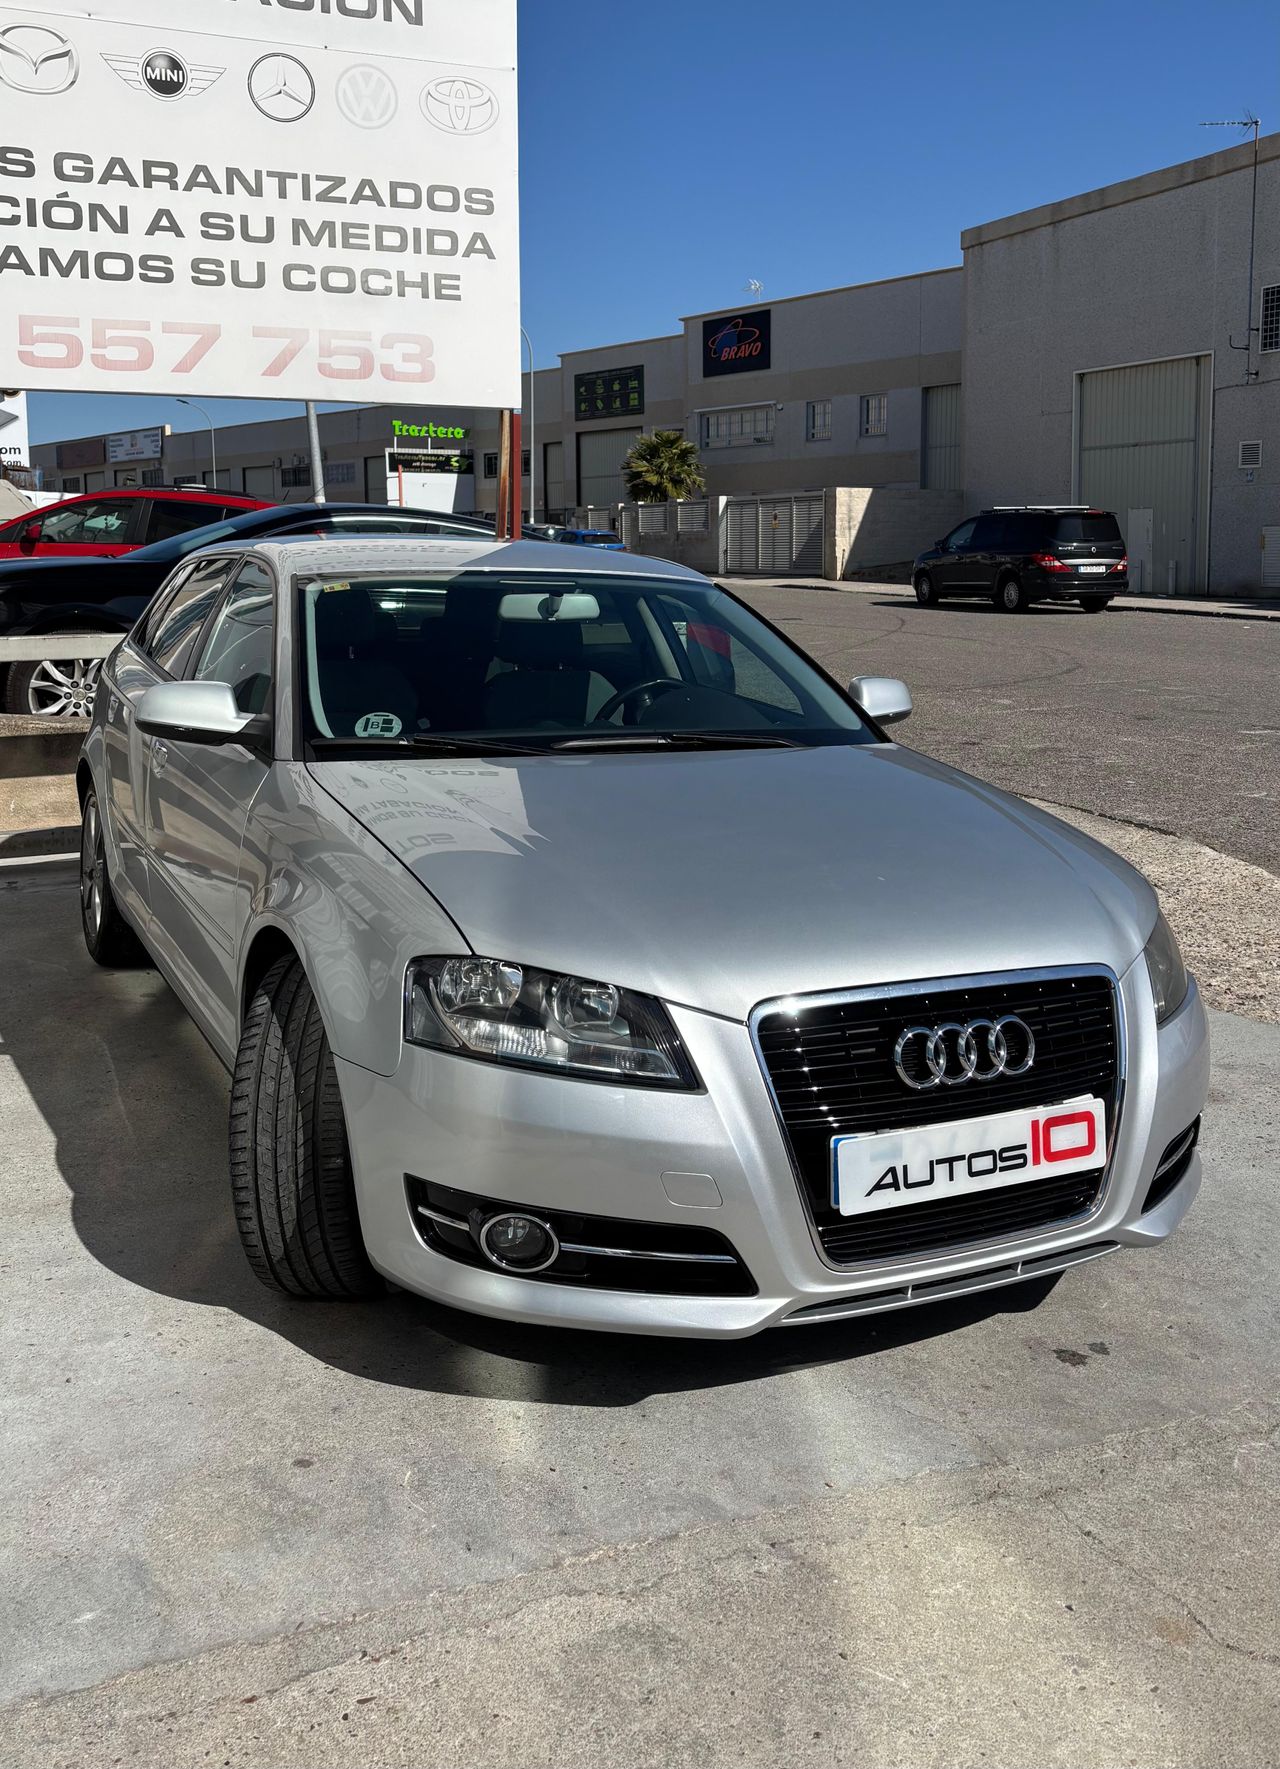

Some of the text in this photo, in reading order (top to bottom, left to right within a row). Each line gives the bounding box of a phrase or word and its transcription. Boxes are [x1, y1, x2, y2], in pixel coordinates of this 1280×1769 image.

[145, 65, 185, 84] MINI
[53, 151, 496, 216] GARANTIZADOS
[144, 208, 186, 239] A
[199, 211, 275, 244] SU
[291, 217, 497, 260] MEDIDA
[0, 244, 462, 302] AMOS SU COCHE
[17, 314, 436, 385] 557 753
[721, 341, 762, 361] BRAVO
[370, 721, 380, 729] B
